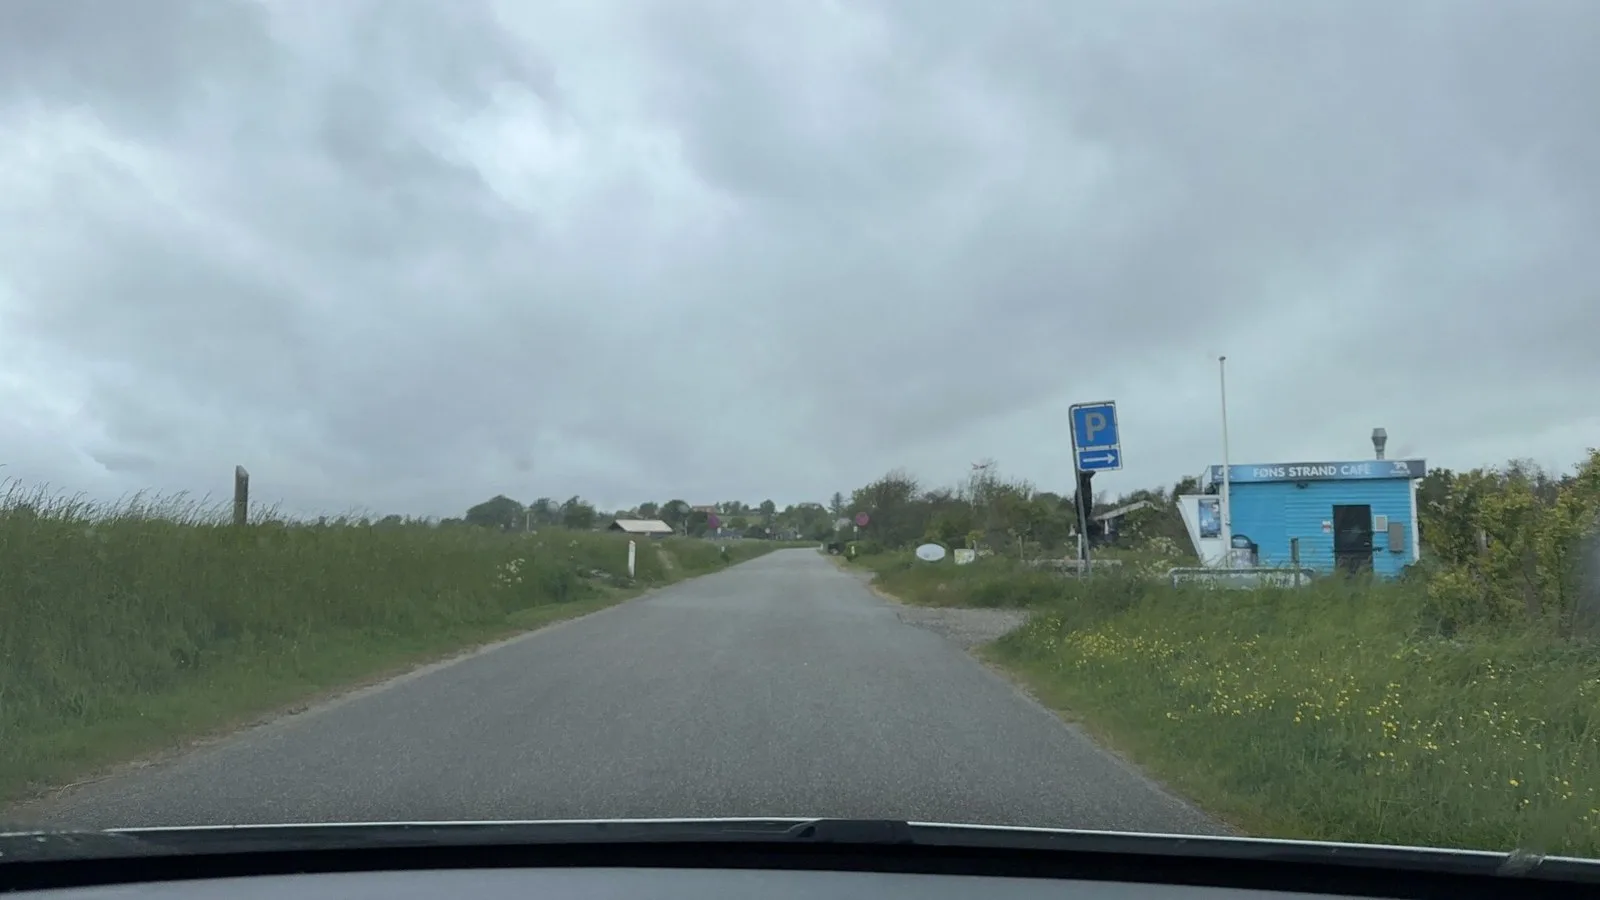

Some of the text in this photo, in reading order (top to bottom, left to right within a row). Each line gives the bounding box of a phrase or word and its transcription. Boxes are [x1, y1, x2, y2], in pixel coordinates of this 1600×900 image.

[1085, 412, 1106, 441] P
[1253, 467, 1285, 478] FØNS
[1288, 466, 1337, 477] STRAND
